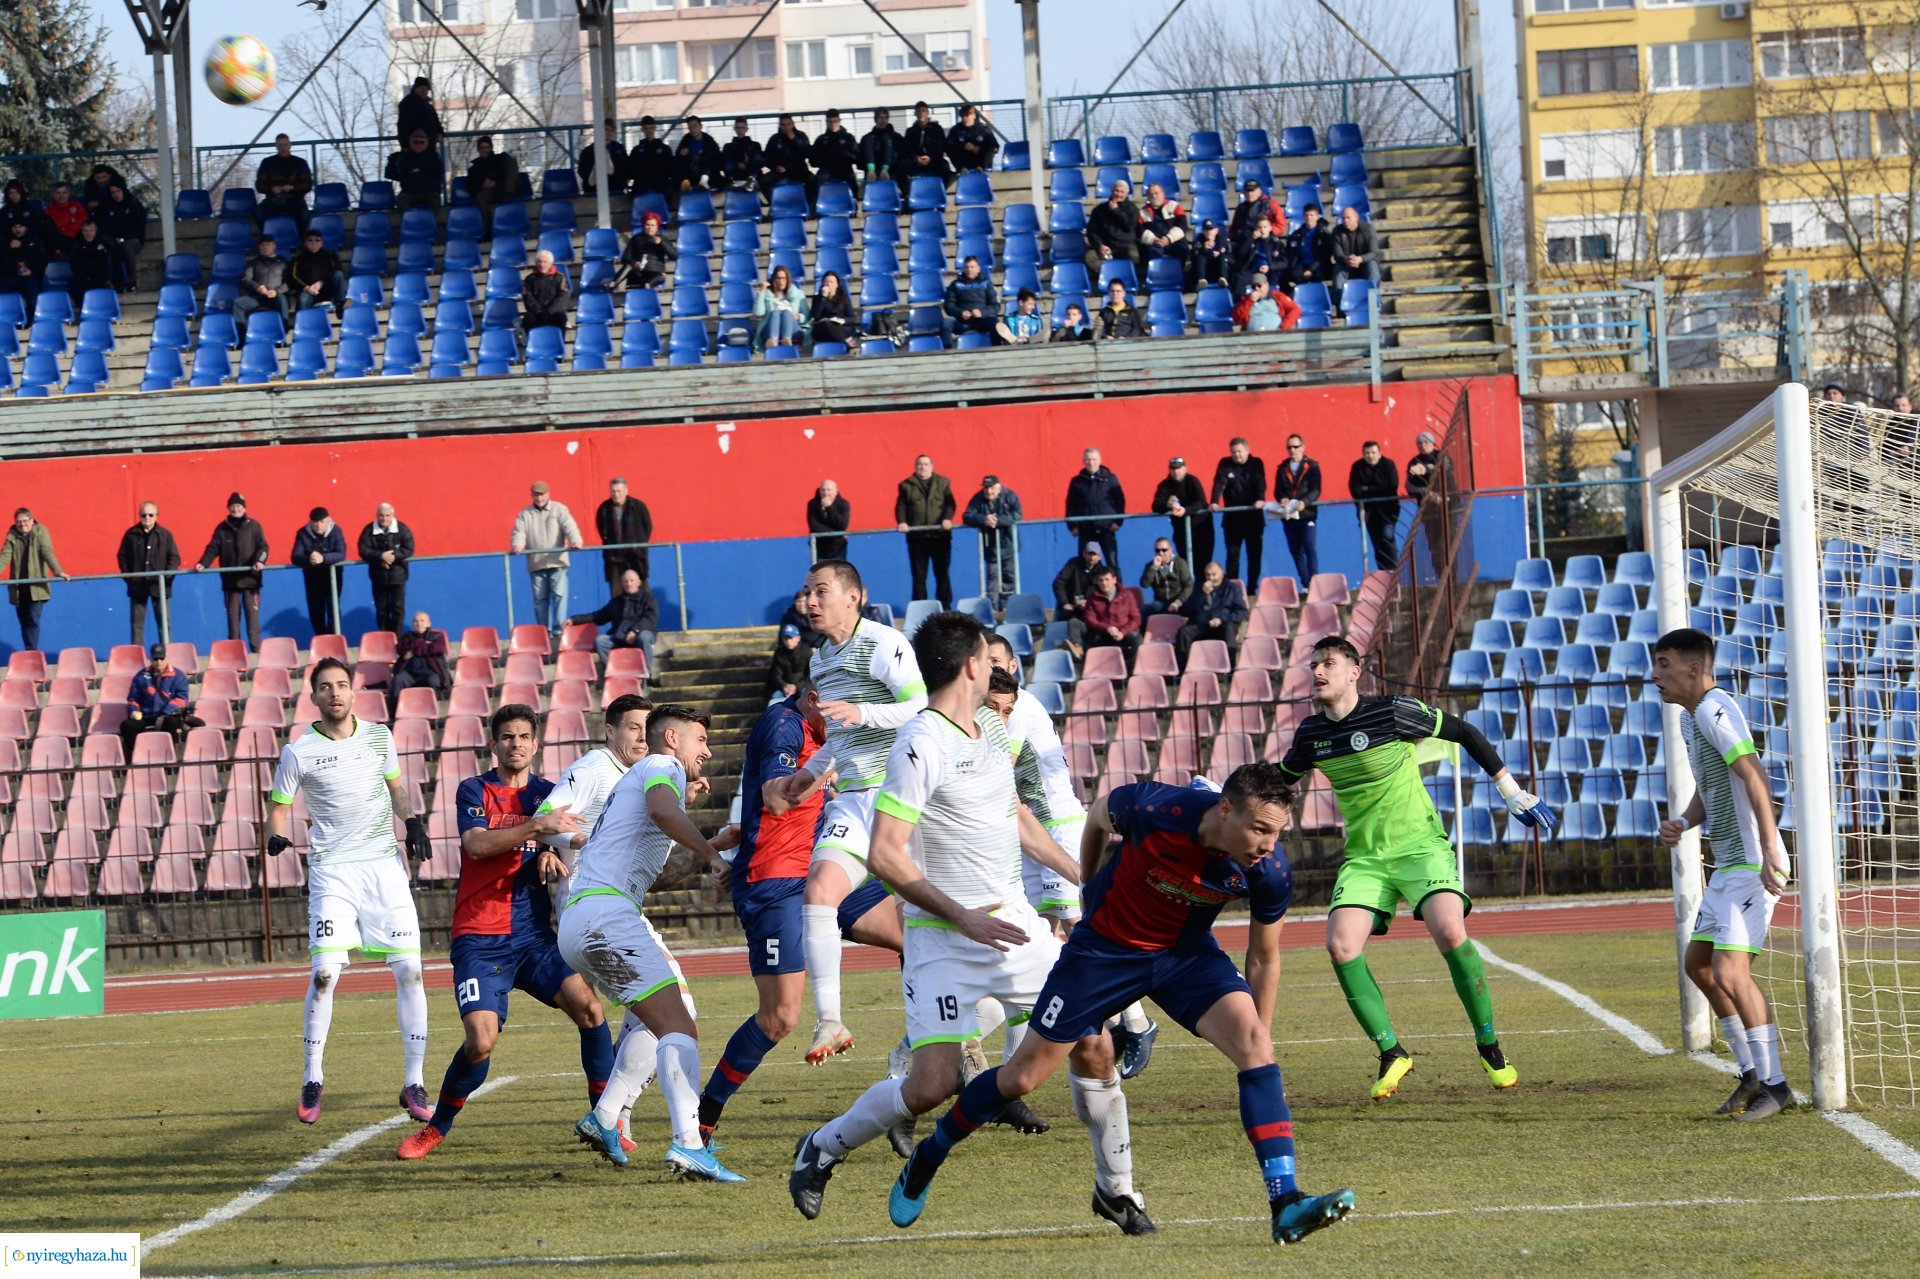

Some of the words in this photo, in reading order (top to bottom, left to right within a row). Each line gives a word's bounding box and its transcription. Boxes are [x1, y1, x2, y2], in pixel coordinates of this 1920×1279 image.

[822, 823, 849, 838] 33
[316, 919, 334, 938] 26
[0, 926, 99, 998] nk
[766, 938, 780, 966] 5
[458, 977, 480, 1008] 20
[935, 994, 958, 1022] 19
[1040, 994, 1064, 1029] 8
